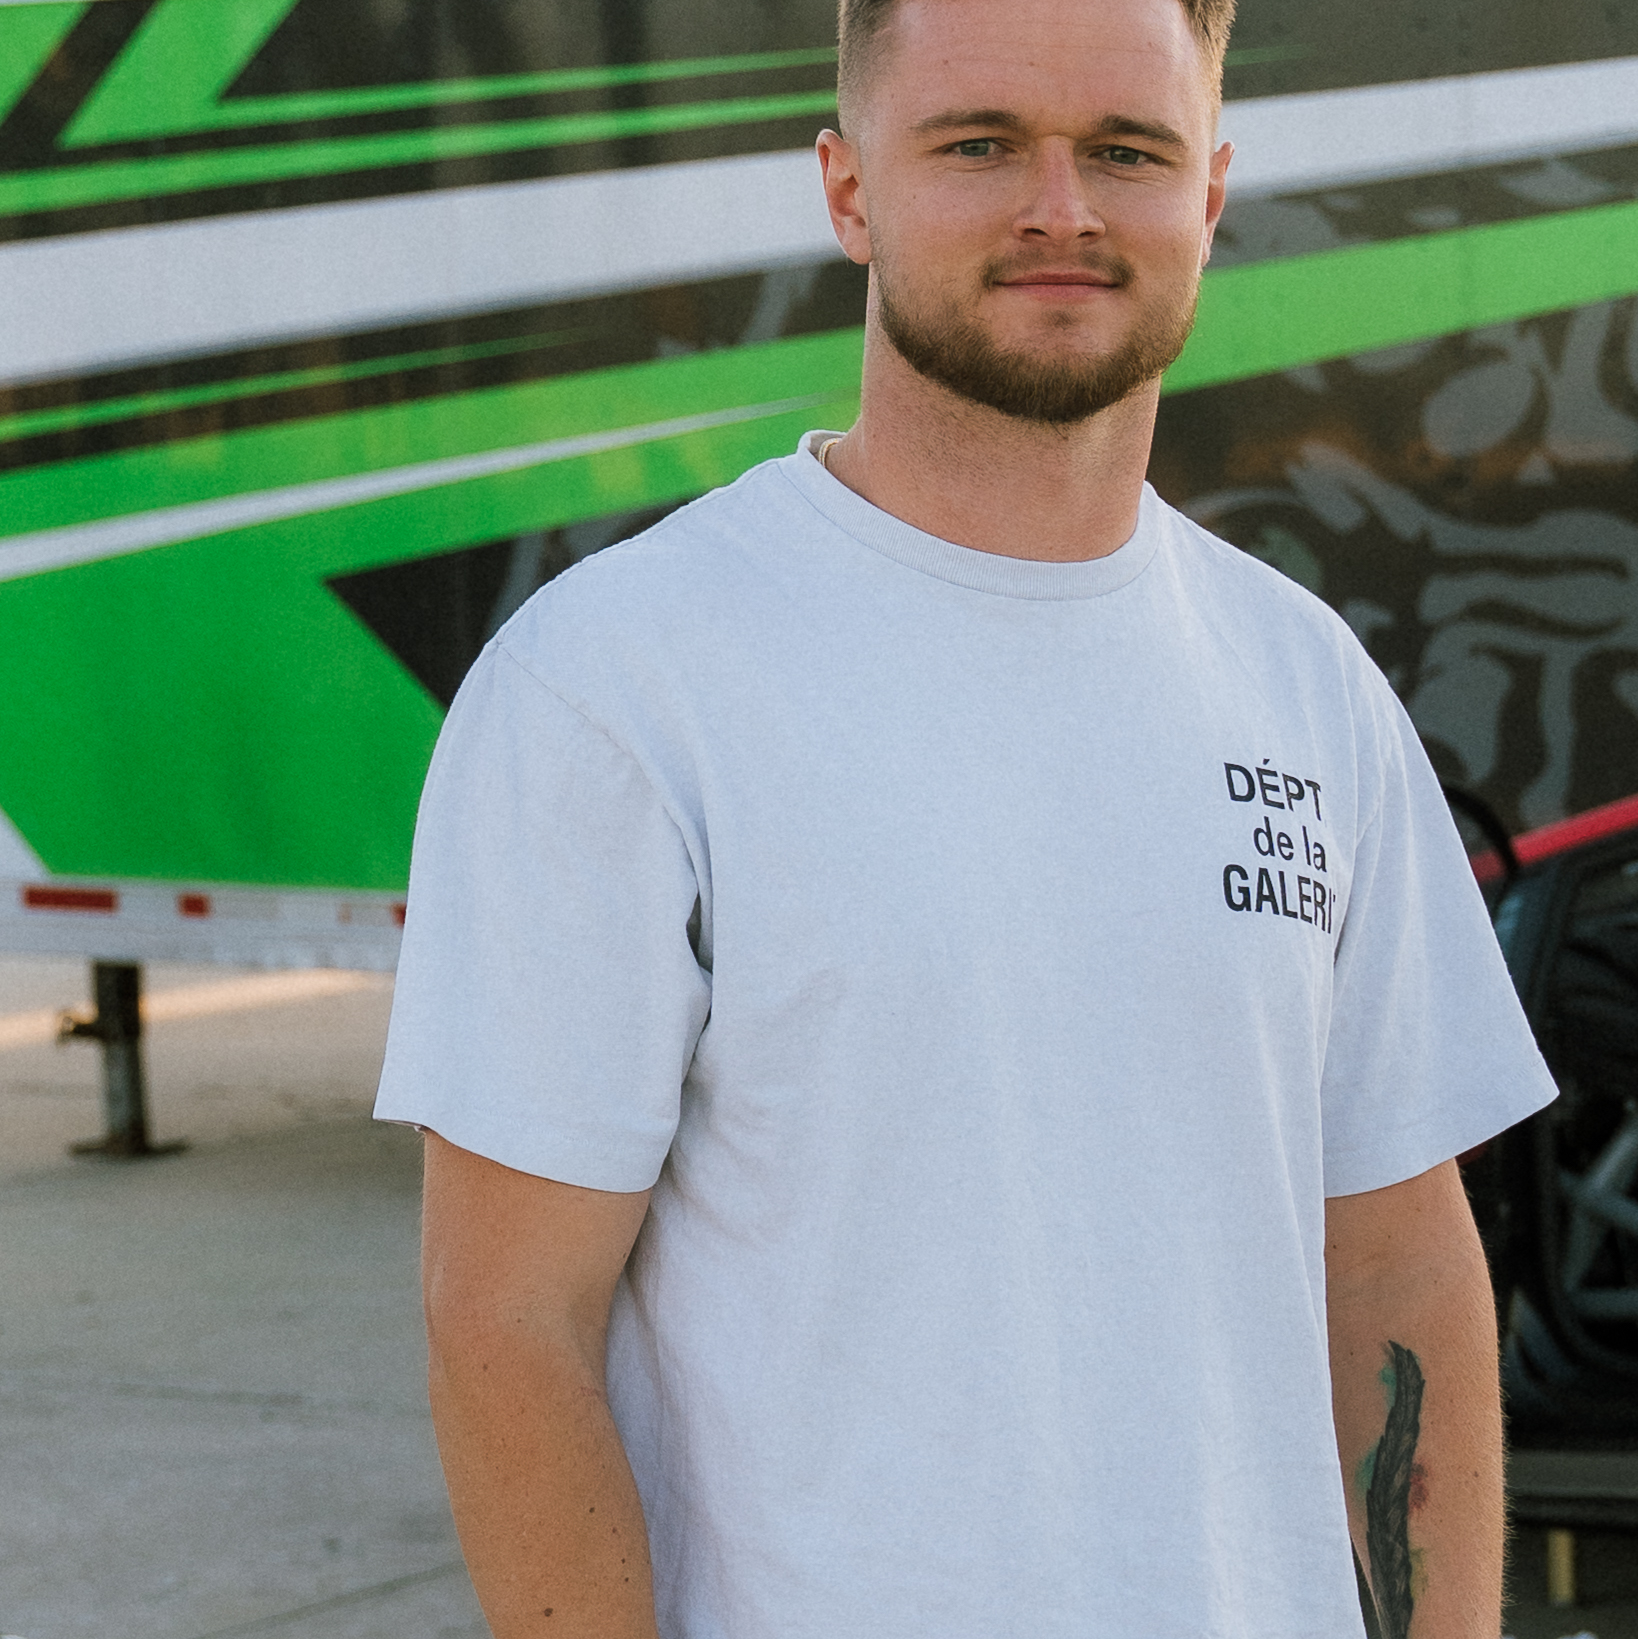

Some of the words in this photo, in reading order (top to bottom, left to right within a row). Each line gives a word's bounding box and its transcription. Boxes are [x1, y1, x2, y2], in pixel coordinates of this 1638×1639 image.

[1223, 757, 1323, 822] DÉPT
[1253, 815, 1295, 861] de
[1302, 824, 1328, 873] la
[1222, 863, 1337, 934] GALERI
